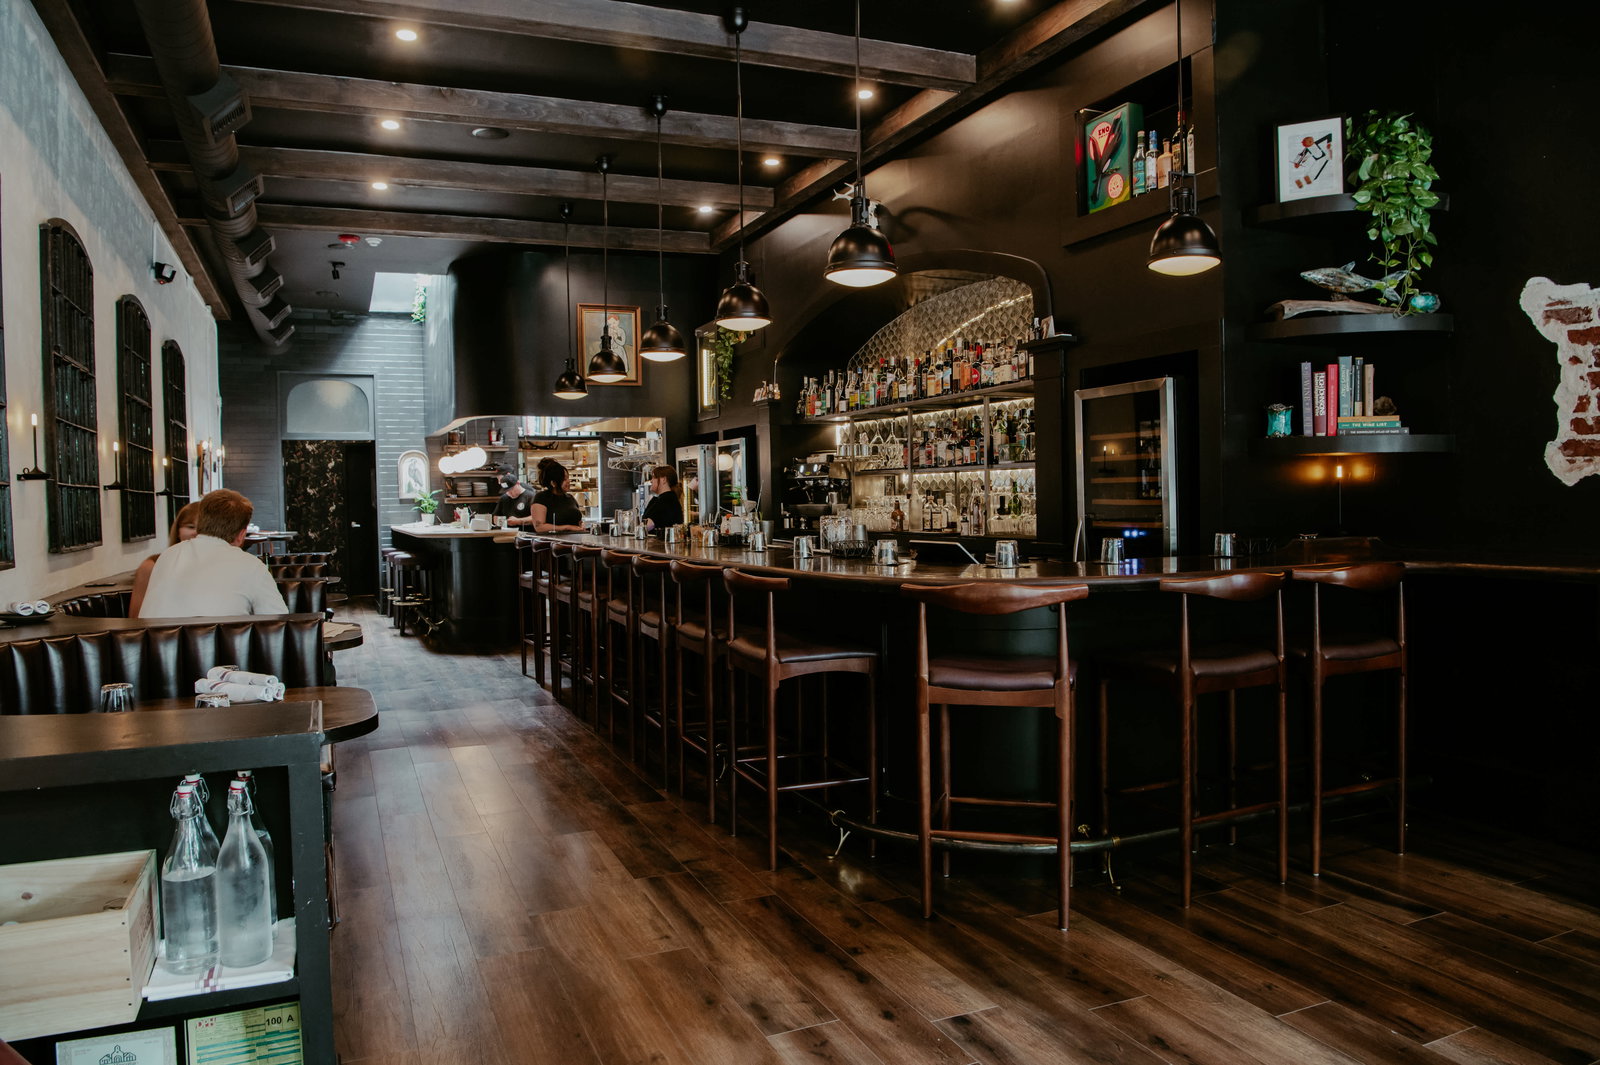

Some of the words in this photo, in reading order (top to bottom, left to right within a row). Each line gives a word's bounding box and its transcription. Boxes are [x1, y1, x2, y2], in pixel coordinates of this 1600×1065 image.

[1098, 126, 1109, 135] ENO
[266, 1016, 282, 1026] 100
[287, 1014, 295, 1023] A
